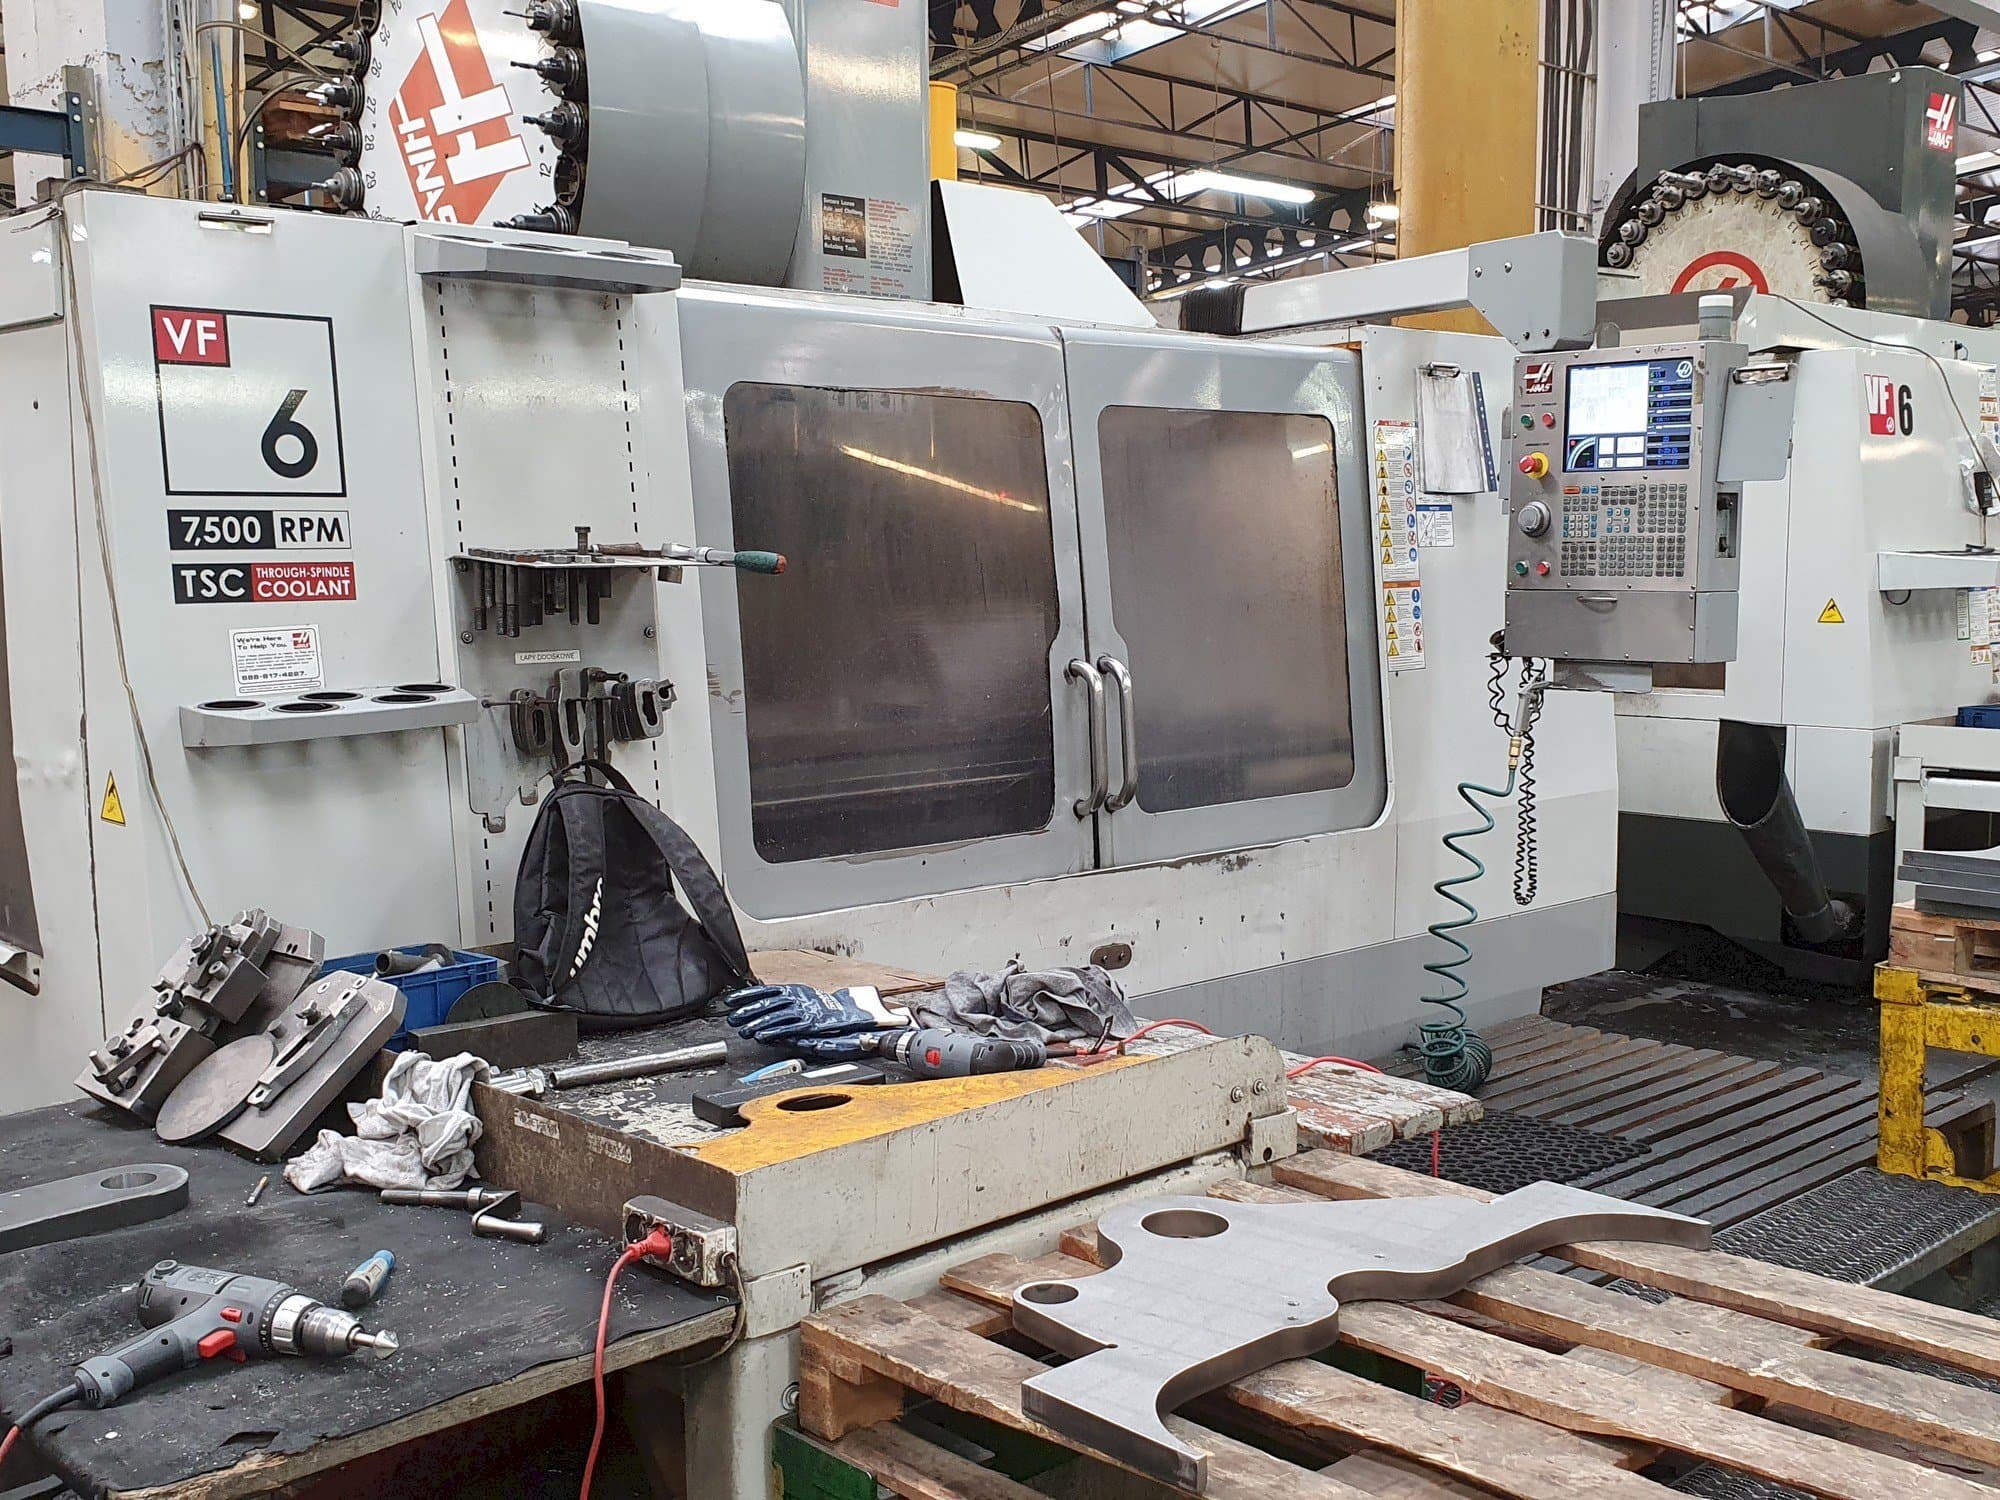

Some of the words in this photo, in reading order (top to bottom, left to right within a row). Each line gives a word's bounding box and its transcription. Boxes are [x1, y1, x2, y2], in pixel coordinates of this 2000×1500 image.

[371, 57, 382, 78] 26
[367, 96, 376, 115] 27
[364, 134, 375, 151] 28
[365, 171, 376, 189] 29
[539, 162, 552, 178] 12
[162, 317, 218, 356] VF
[1864, 373, 1890, 415] VF
[1898, 385, 1913, 436] 6
[261, 389, 318, 478] 6
[181, 515, 262, 547] 7,500
[279, 517, 344, 544] RPM
[180, 568, 246, 598] TSC
[256, 566, 350, 579] THROUGH-SPINDLE
[257, 580, 351, 598] COOLANT
